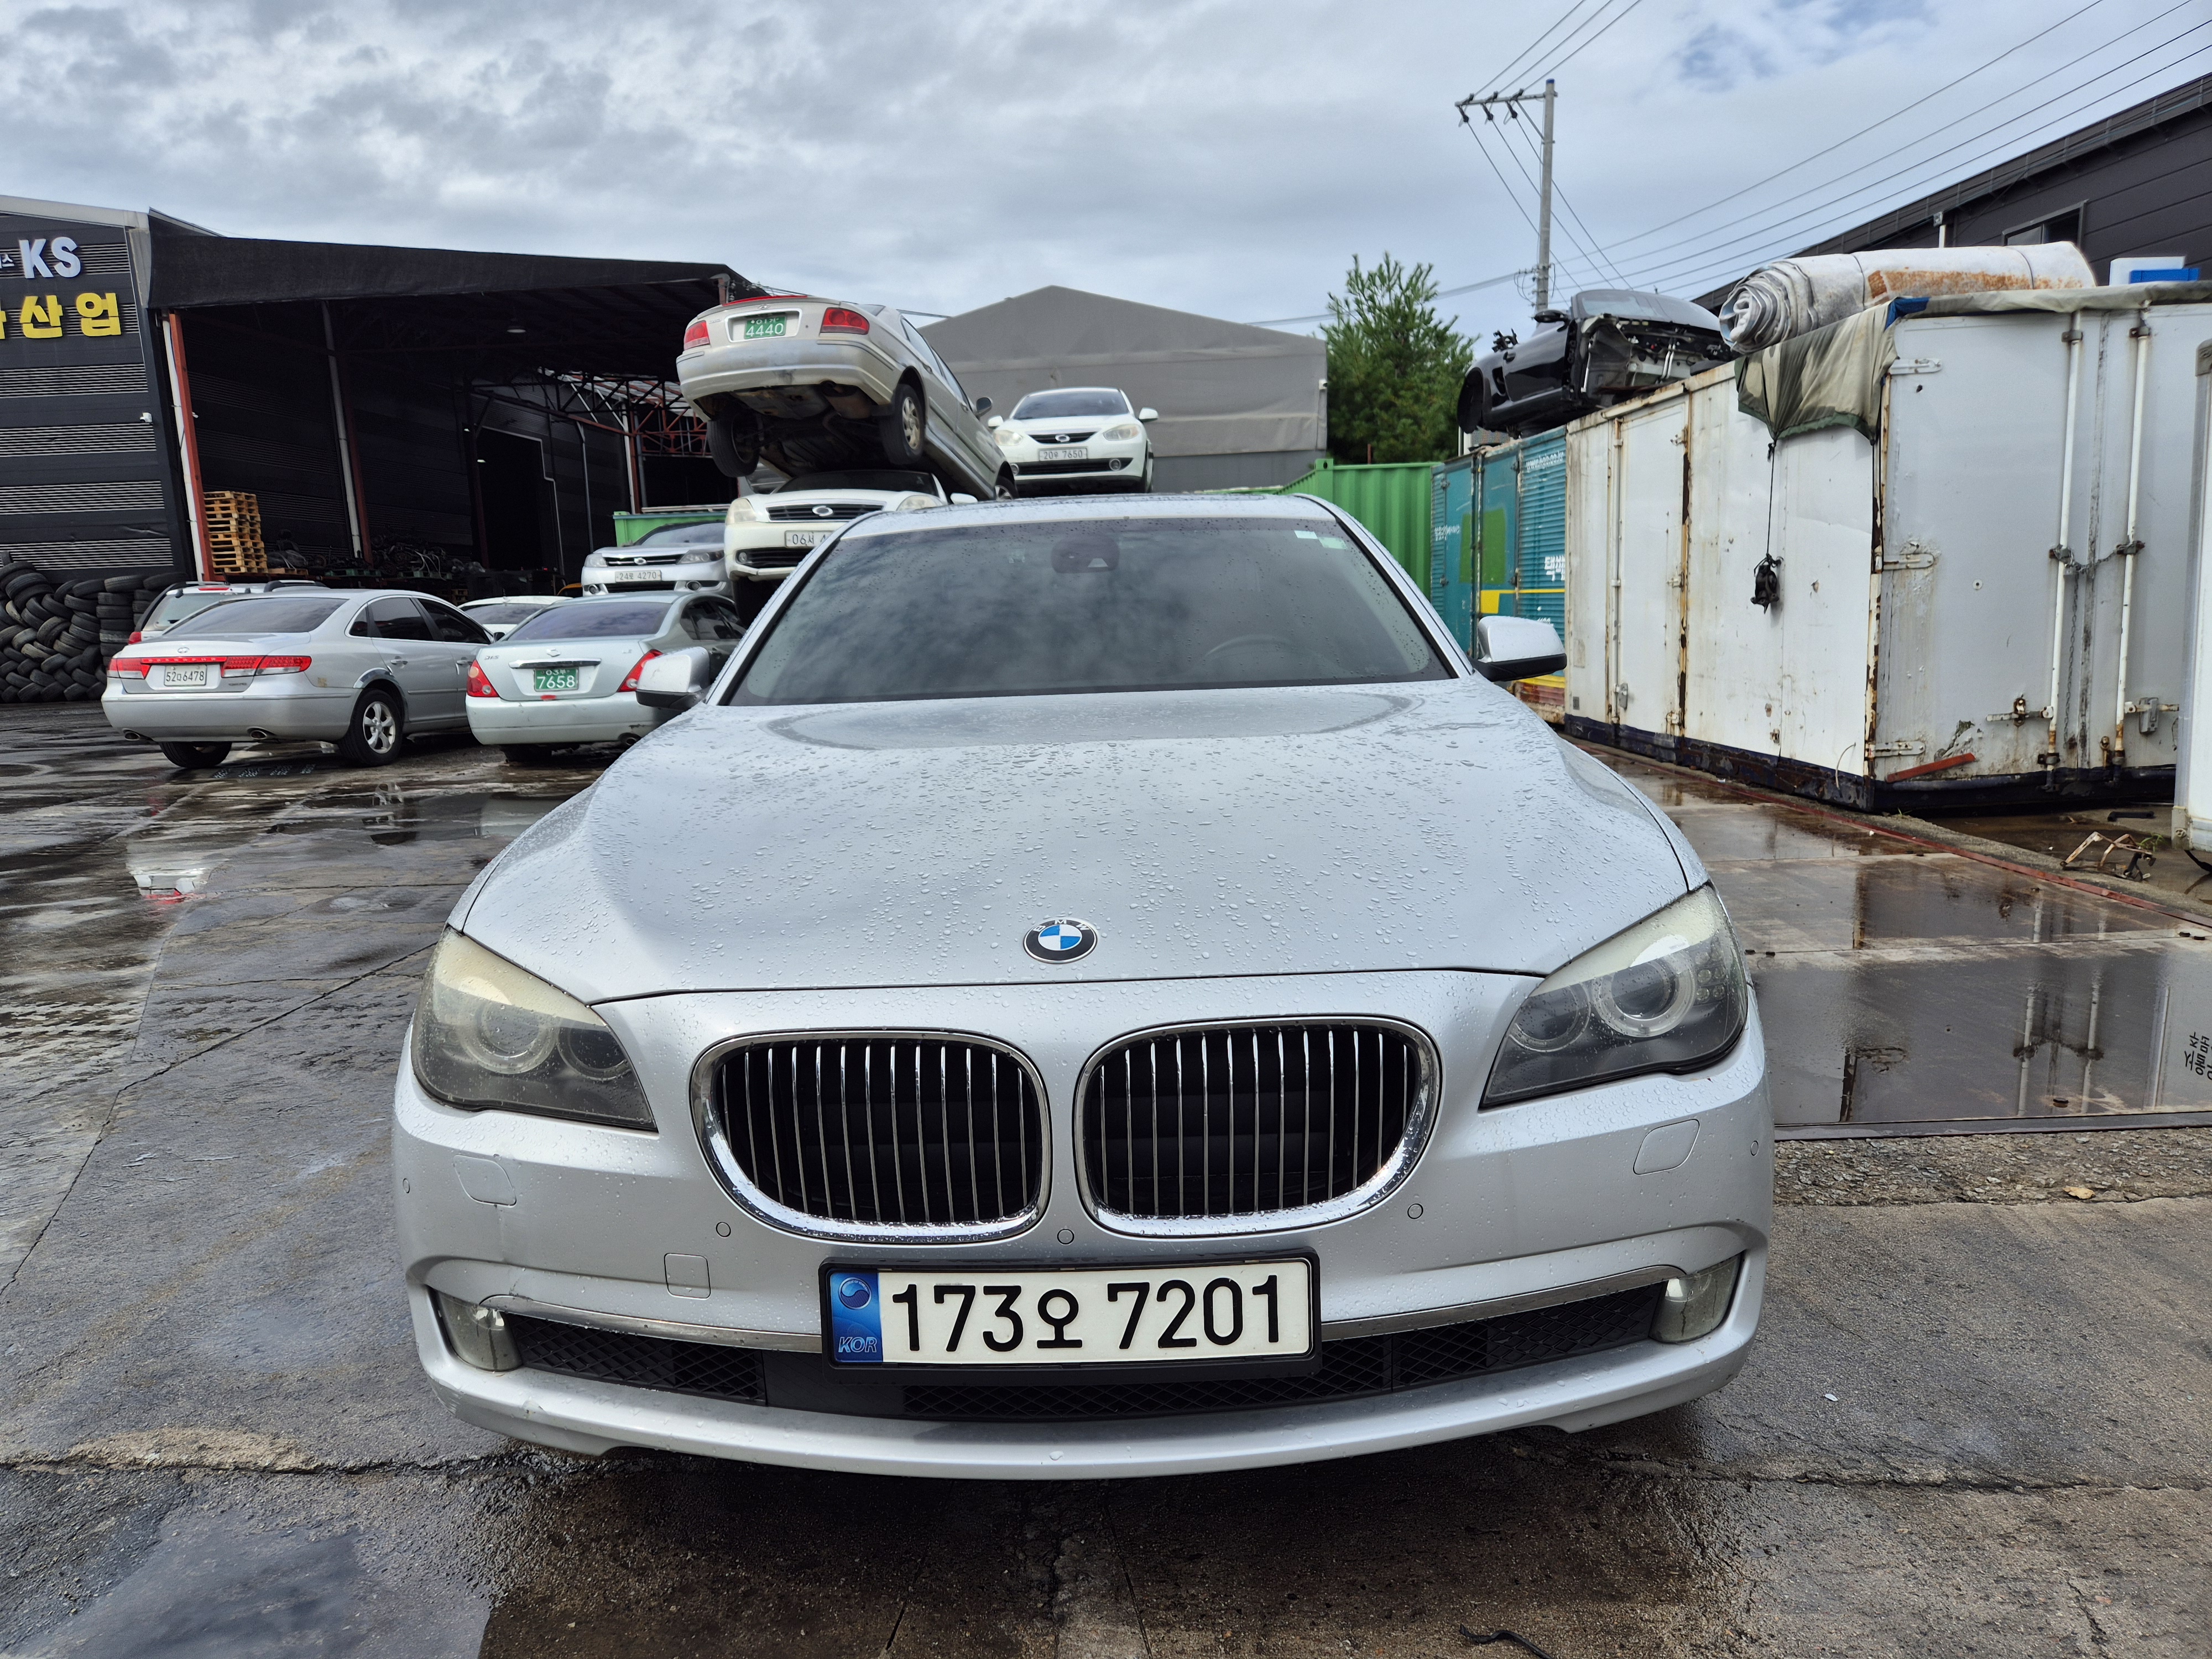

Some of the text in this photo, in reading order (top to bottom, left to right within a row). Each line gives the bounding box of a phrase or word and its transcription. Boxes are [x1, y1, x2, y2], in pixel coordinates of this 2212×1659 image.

[0, 236, 81, 279] 스 KS
[746, 323, 784, 337] 4440
[1062, 450, 1083, 458] 7650
[792, 534, 815, 545] 06서
[637, 571, 657, 580] 4270
[536, 675, 575, 689] 7658
[1032, 920, 1089, 932] BMW
[892, 1274, 1280, 1352] 173오 7201
[838, 1336, 878, 1353] KOR
